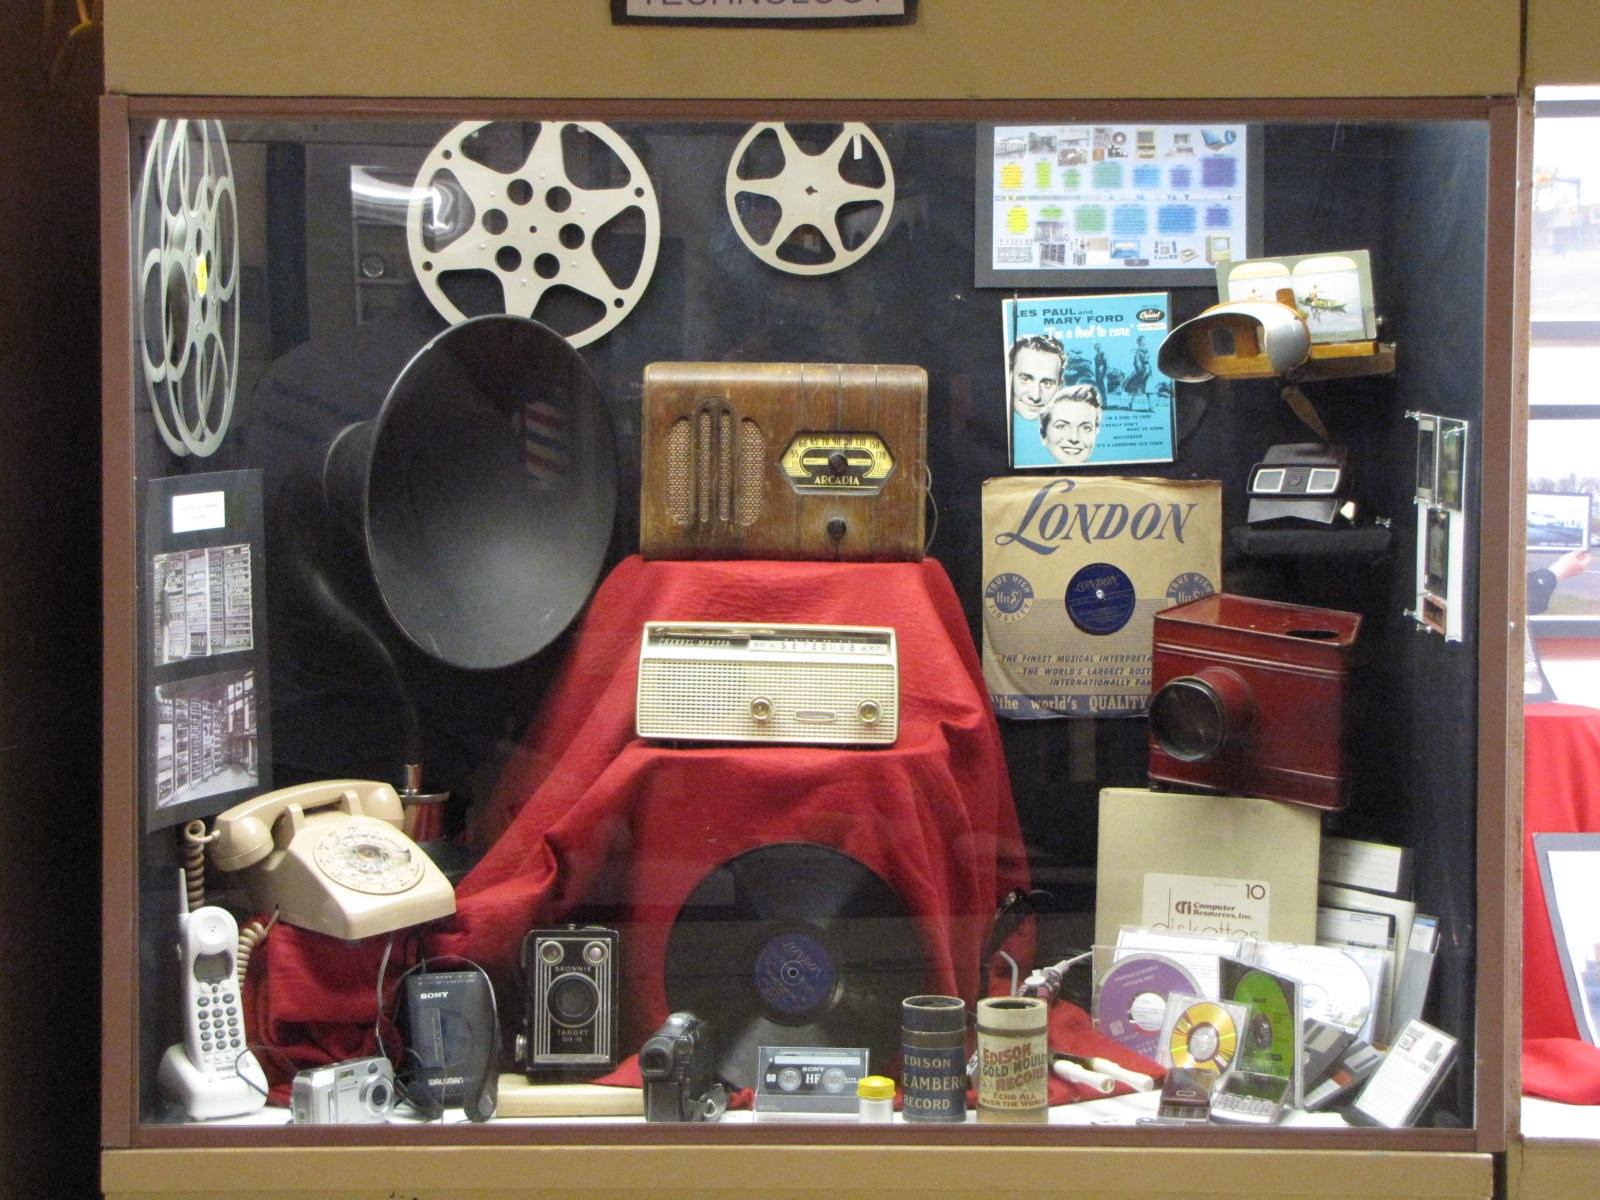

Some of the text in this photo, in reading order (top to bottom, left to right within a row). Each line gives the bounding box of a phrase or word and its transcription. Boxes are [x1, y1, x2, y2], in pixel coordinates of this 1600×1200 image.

[1042, 307, 1076, 317] PAUL
[1043, 314, 1125, 326] MARY FORD
[1074, 325, 1096, 339] fool
[814, 475, 860, 485] ARCADIA
[986, 574, 1007, 593] TRUE
[1168, 574, 1189, 593] TRUE
[1001, 655, 1018, 664] THE
[1022, 655, 1052, 663] FINEST
[1056, 655, 1095, 663] MUSICAL
[1044, 667, 1082, 675] WORLD'S
[1086, 667, 1125, 675] LARGEST
[1050, 679, 1131, 687] INTERNATIONALLY
[1031, 695, 1078, 711] world's
[1088, 695, 1149, 712] QUALITY
[1244, 883, 1266, 901] 10
[1193, 902, 1236, 912] Computer
[420, 991, 449, 1000] SONY
[983, 1043, 1032, 1065] EDISON
[904, 1054, 951, 1069] EDISON
[982, 1063, 1009, 1077] GOLD
[805, 1073, 821, 1085] HF
[903, 1093, 951, 1110] RECORD
